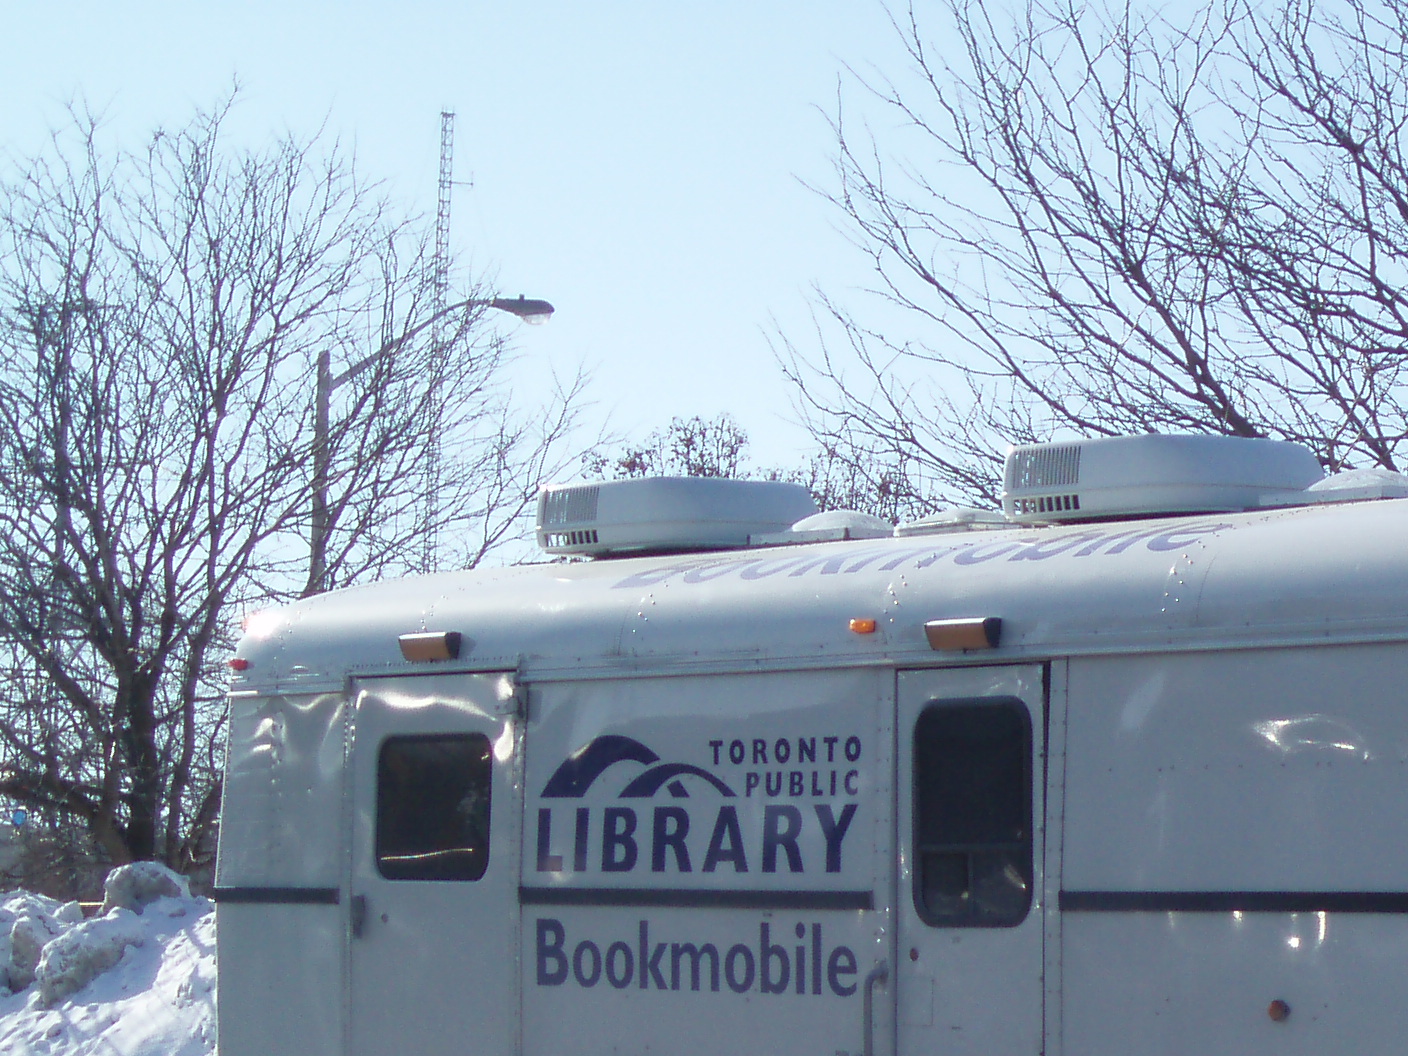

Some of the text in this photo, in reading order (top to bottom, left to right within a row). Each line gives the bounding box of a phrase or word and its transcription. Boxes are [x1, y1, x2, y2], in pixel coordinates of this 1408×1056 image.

[709, 735, 862, 765] TORONTO
[745, 769, 860, 798] PUBLIC
[536, 804, 860, 873] LIBRARY
[536, 918, 858, 996] Bookmobile
